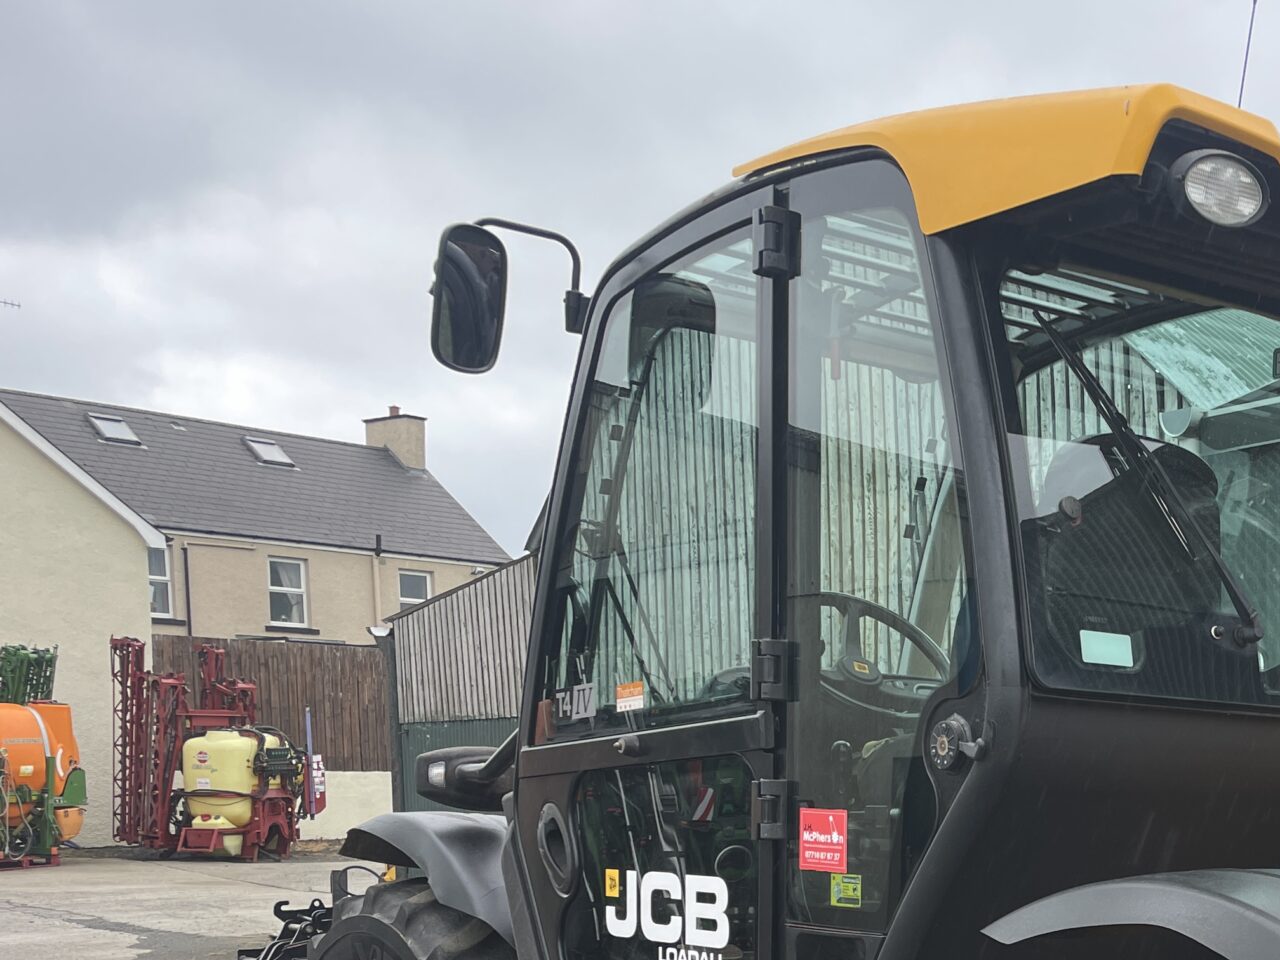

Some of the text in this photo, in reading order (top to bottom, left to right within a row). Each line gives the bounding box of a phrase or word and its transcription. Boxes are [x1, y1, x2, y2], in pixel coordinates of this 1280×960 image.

[556, 687, 592, 717] T4 IV
[605, 870, 730, 949] JCB
